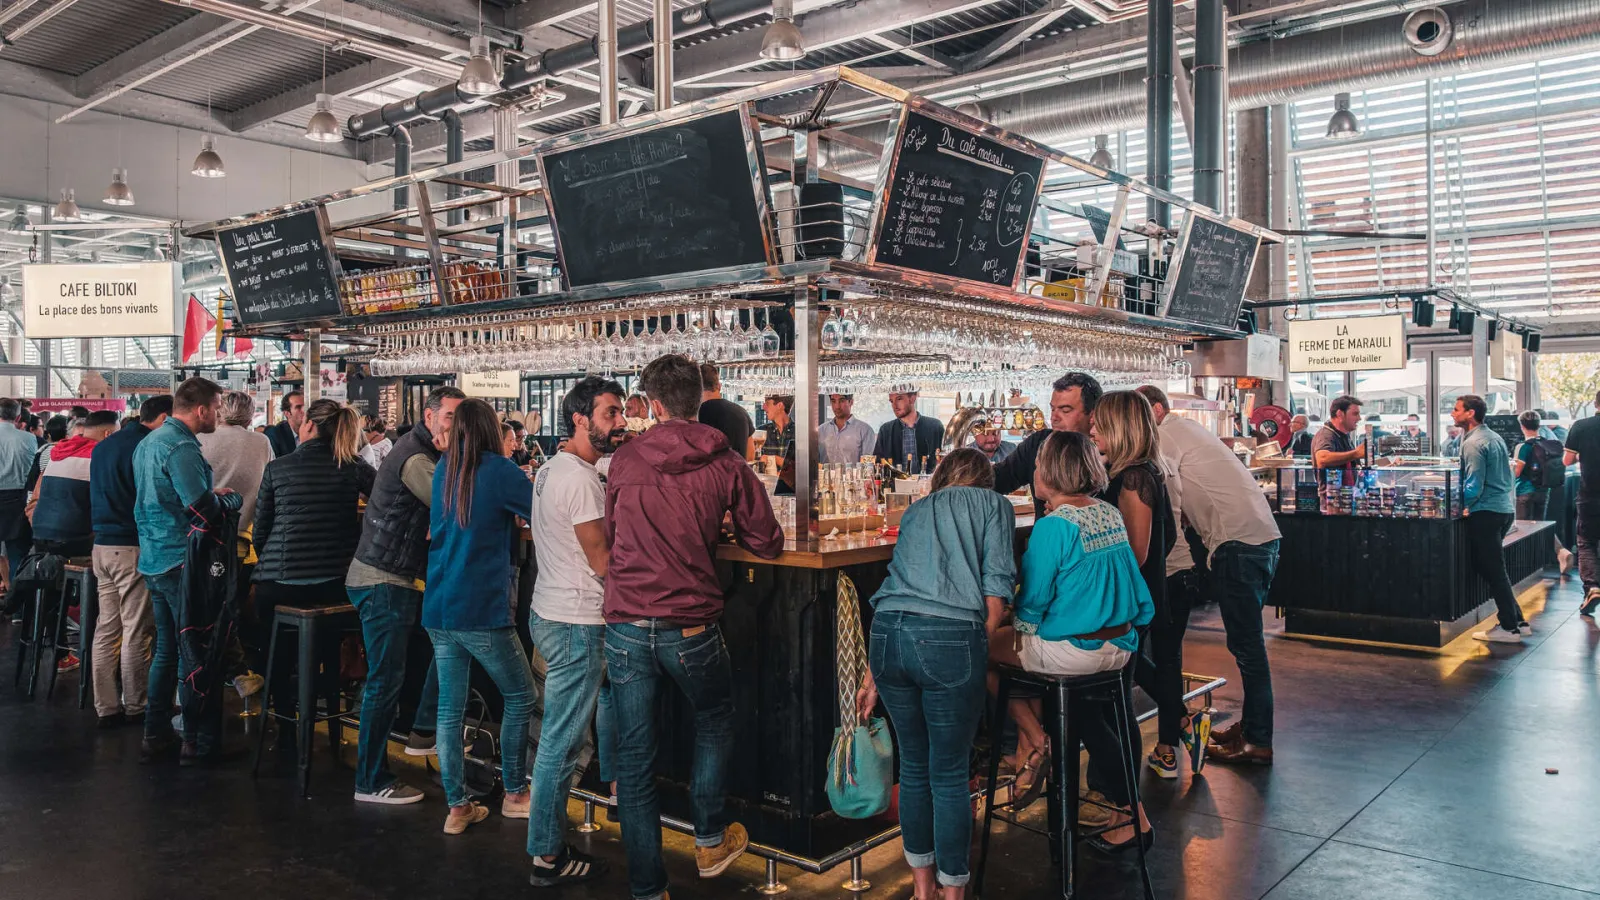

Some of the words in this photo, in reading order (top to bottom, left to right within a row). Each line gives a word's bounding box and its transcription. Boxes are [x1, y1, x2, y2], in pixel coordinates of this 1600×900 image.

[938, 127, 955, 149] Du
[60, 283, 90, 297] CAFE
[95, 282, 137, 297] BILTOKI
[39, 305, 50, 316] La
[53, 304, 78, 318] place
[81, 304, 97, 315] des
[100, 303, 122, 315] bons
[125, 302, 159, 314] vivants
[1336, 325, 1349, 336] LA
[1299, 340, 1330, 352] FERME
[1333, 339, 1346, 350] DE
[1348, 336, 1392, 349] MARAULI
[1308, 356, 1348, 365] Producteur
[1350, 354, 1383, 363] Volailler
